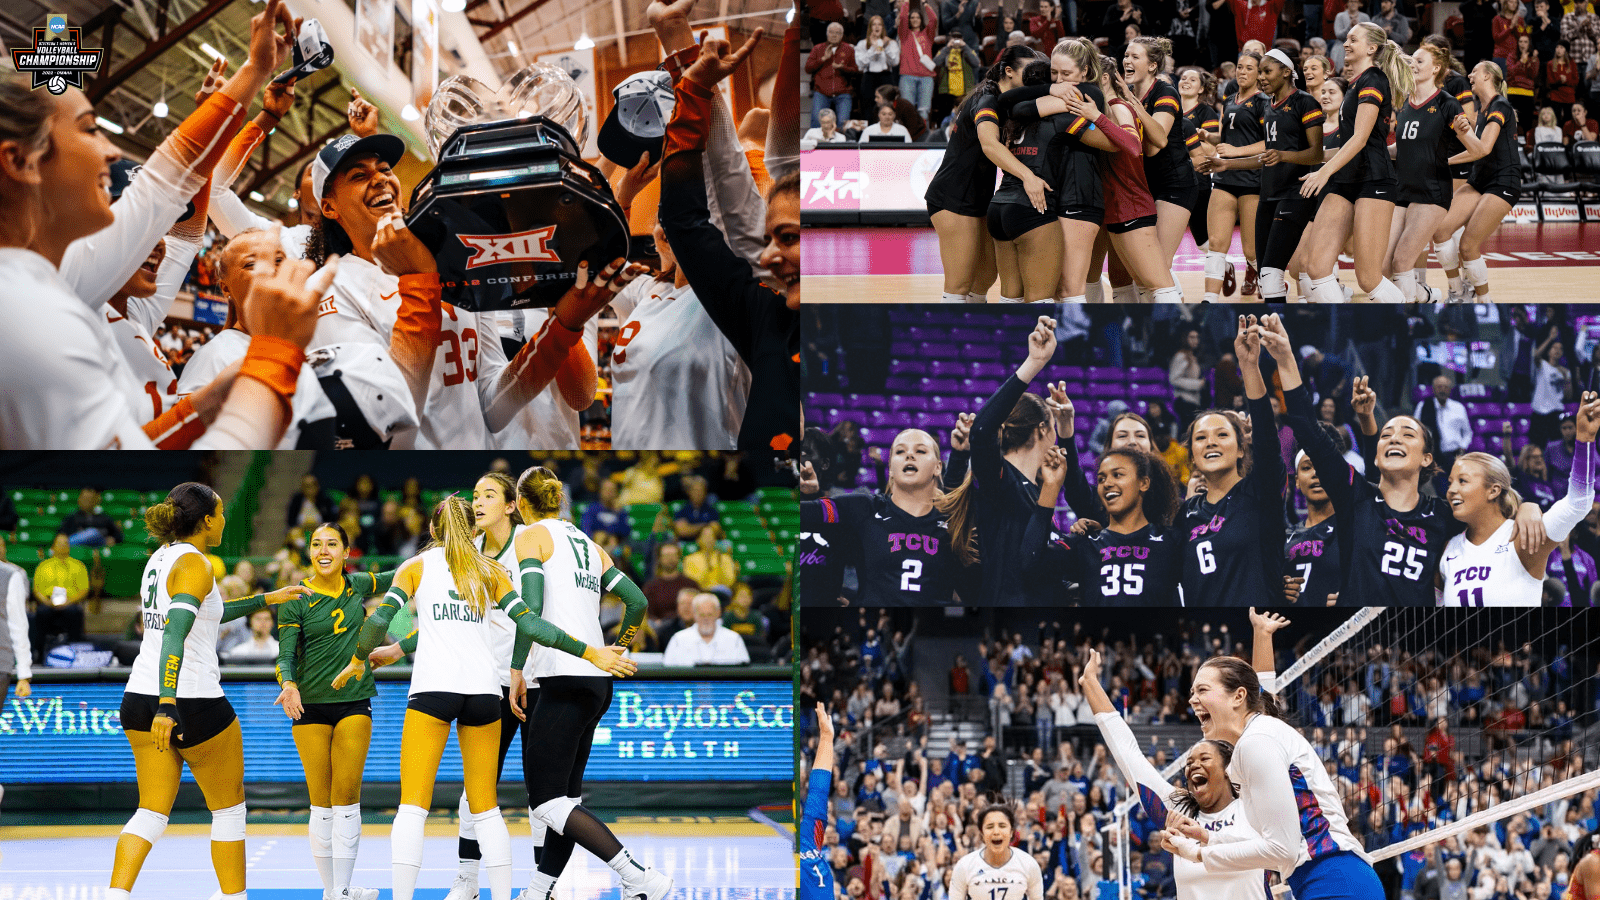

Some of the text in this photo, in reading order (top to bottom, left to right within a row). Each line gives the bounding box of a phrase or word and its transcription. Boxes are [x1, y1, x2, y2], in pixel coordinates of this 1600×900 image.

[1228, 112, 1237, 130] 7
[1265, 121, 1278, 142] 14
[1401, 120, 1420, 140] 16
[464, 279, 481, 287] 12
[613, 320, 642, 365] 9
[437, 327, 478, 387] 33
[566, 534, 590, 571] 17
[888, 532, 939, 556] TCU
[1100, 545, 1150, 562] TCU
[1289, 540, 1324, 560] TCU
[1196, 540, 1217, 575] 6
[1381, 541, 1428, 581] 25
[900, 558, 923, 592] 2
[1100, 563, 1146, 597] 35
[1454, 566, 1492, 586] TCU
[1457, 587, 1484, 607] 11
[331, 608, 348, 635] 2
[618, 740, 740, 758] HEALTH
[812, 864, 826, 888] 1
[988, 887, 1009, 900] 17
